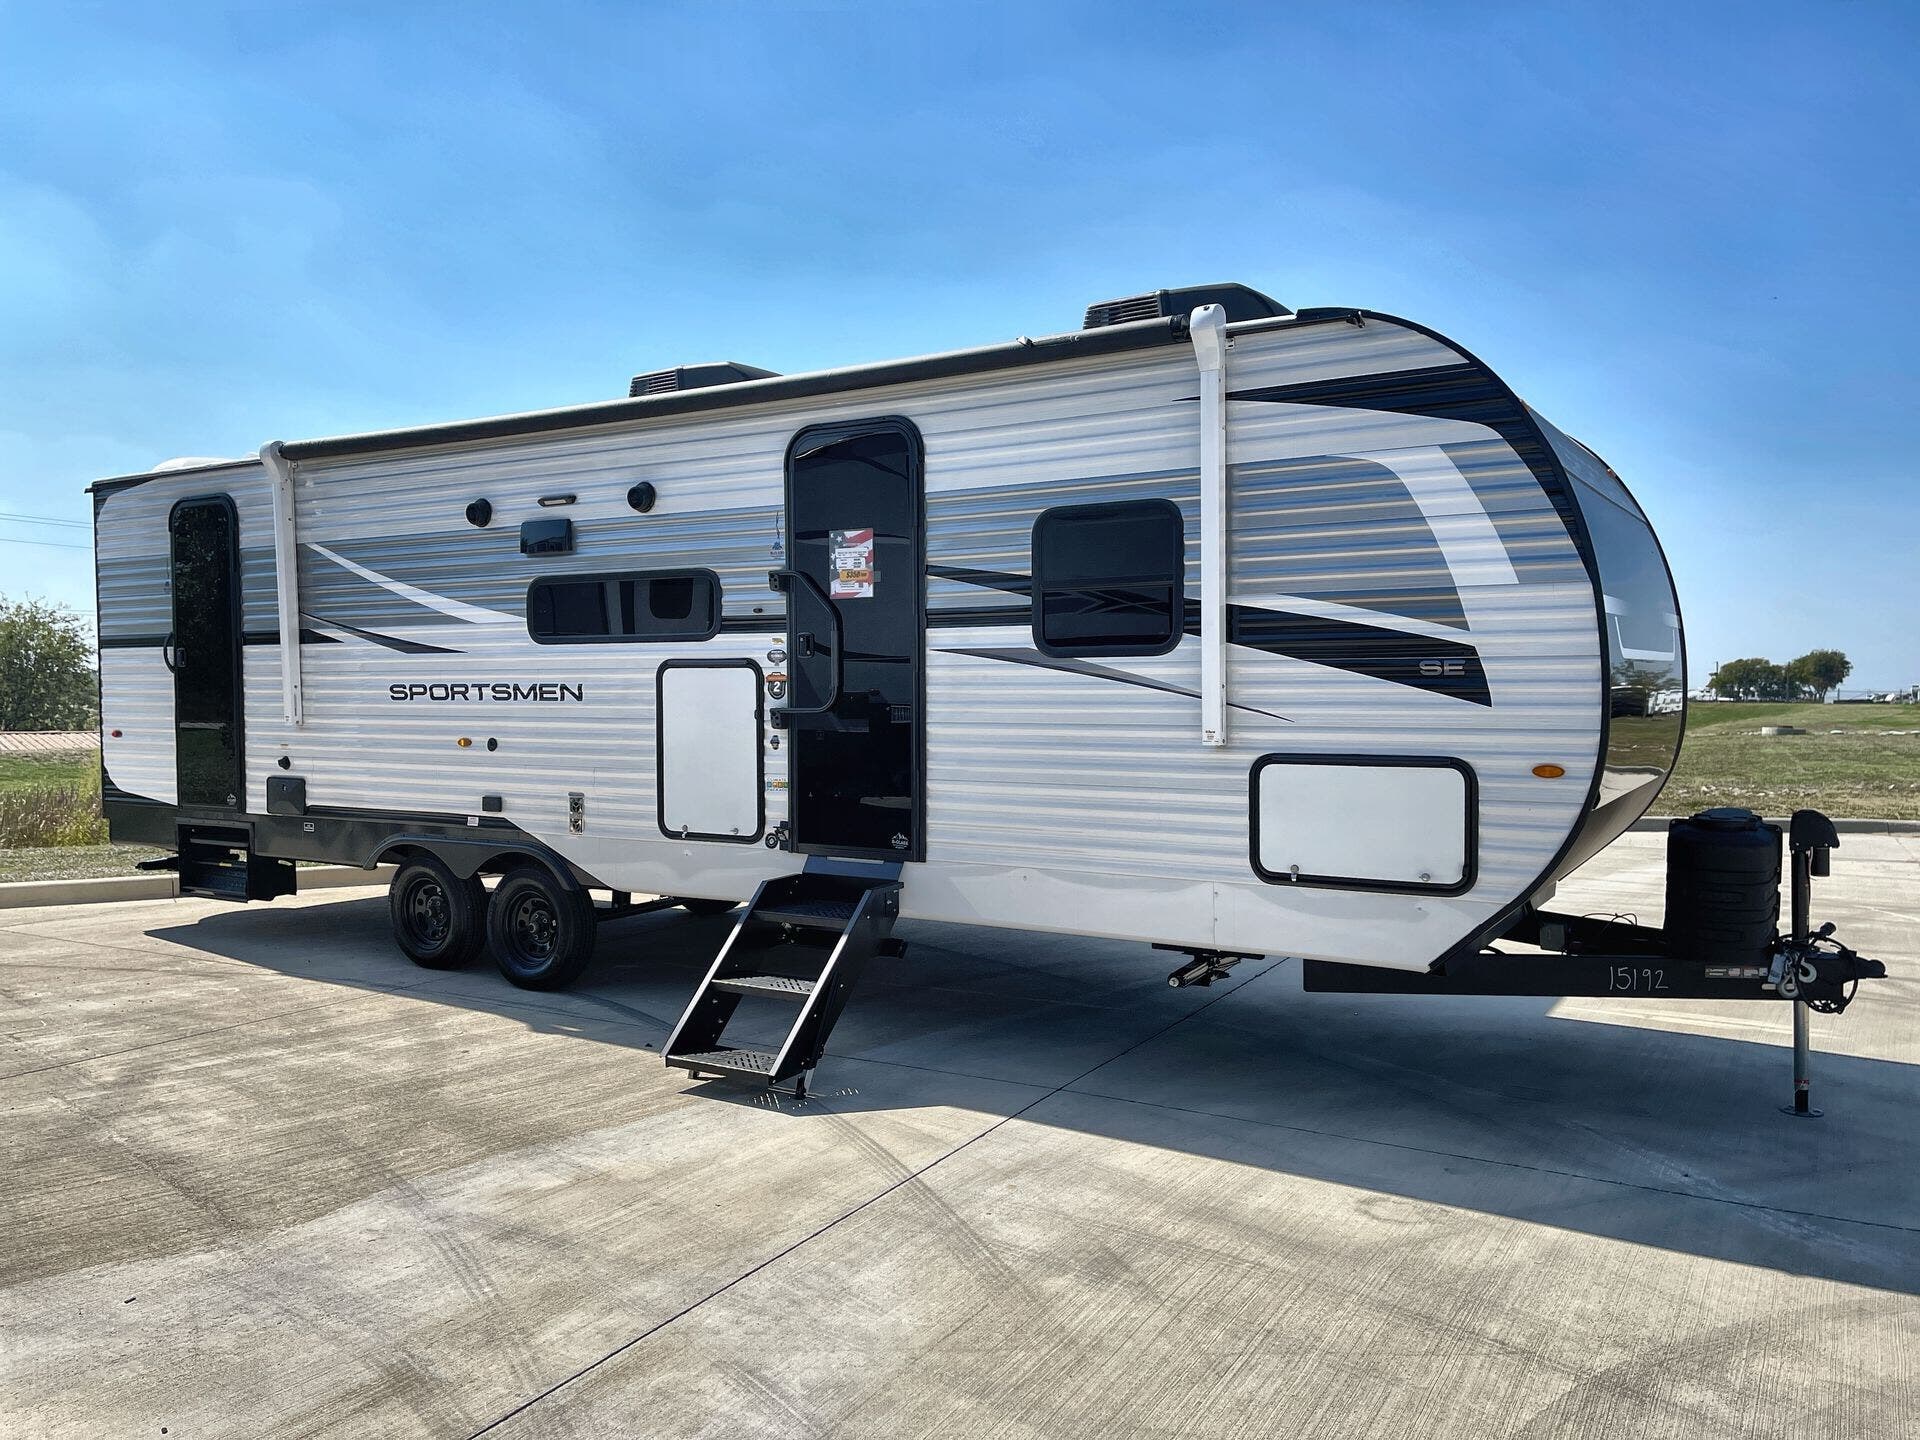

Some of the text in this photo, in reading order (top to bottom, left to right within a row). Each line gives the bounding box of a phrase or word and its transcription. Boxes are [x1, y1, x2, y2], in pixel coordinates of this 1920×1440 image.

[1419, 660, 1466, 676] SE
[389, 683, 583, 702] SPORTSMEN
[773, 681, 781, 692] 2
[1609, 966, 1669, 991] 15192
